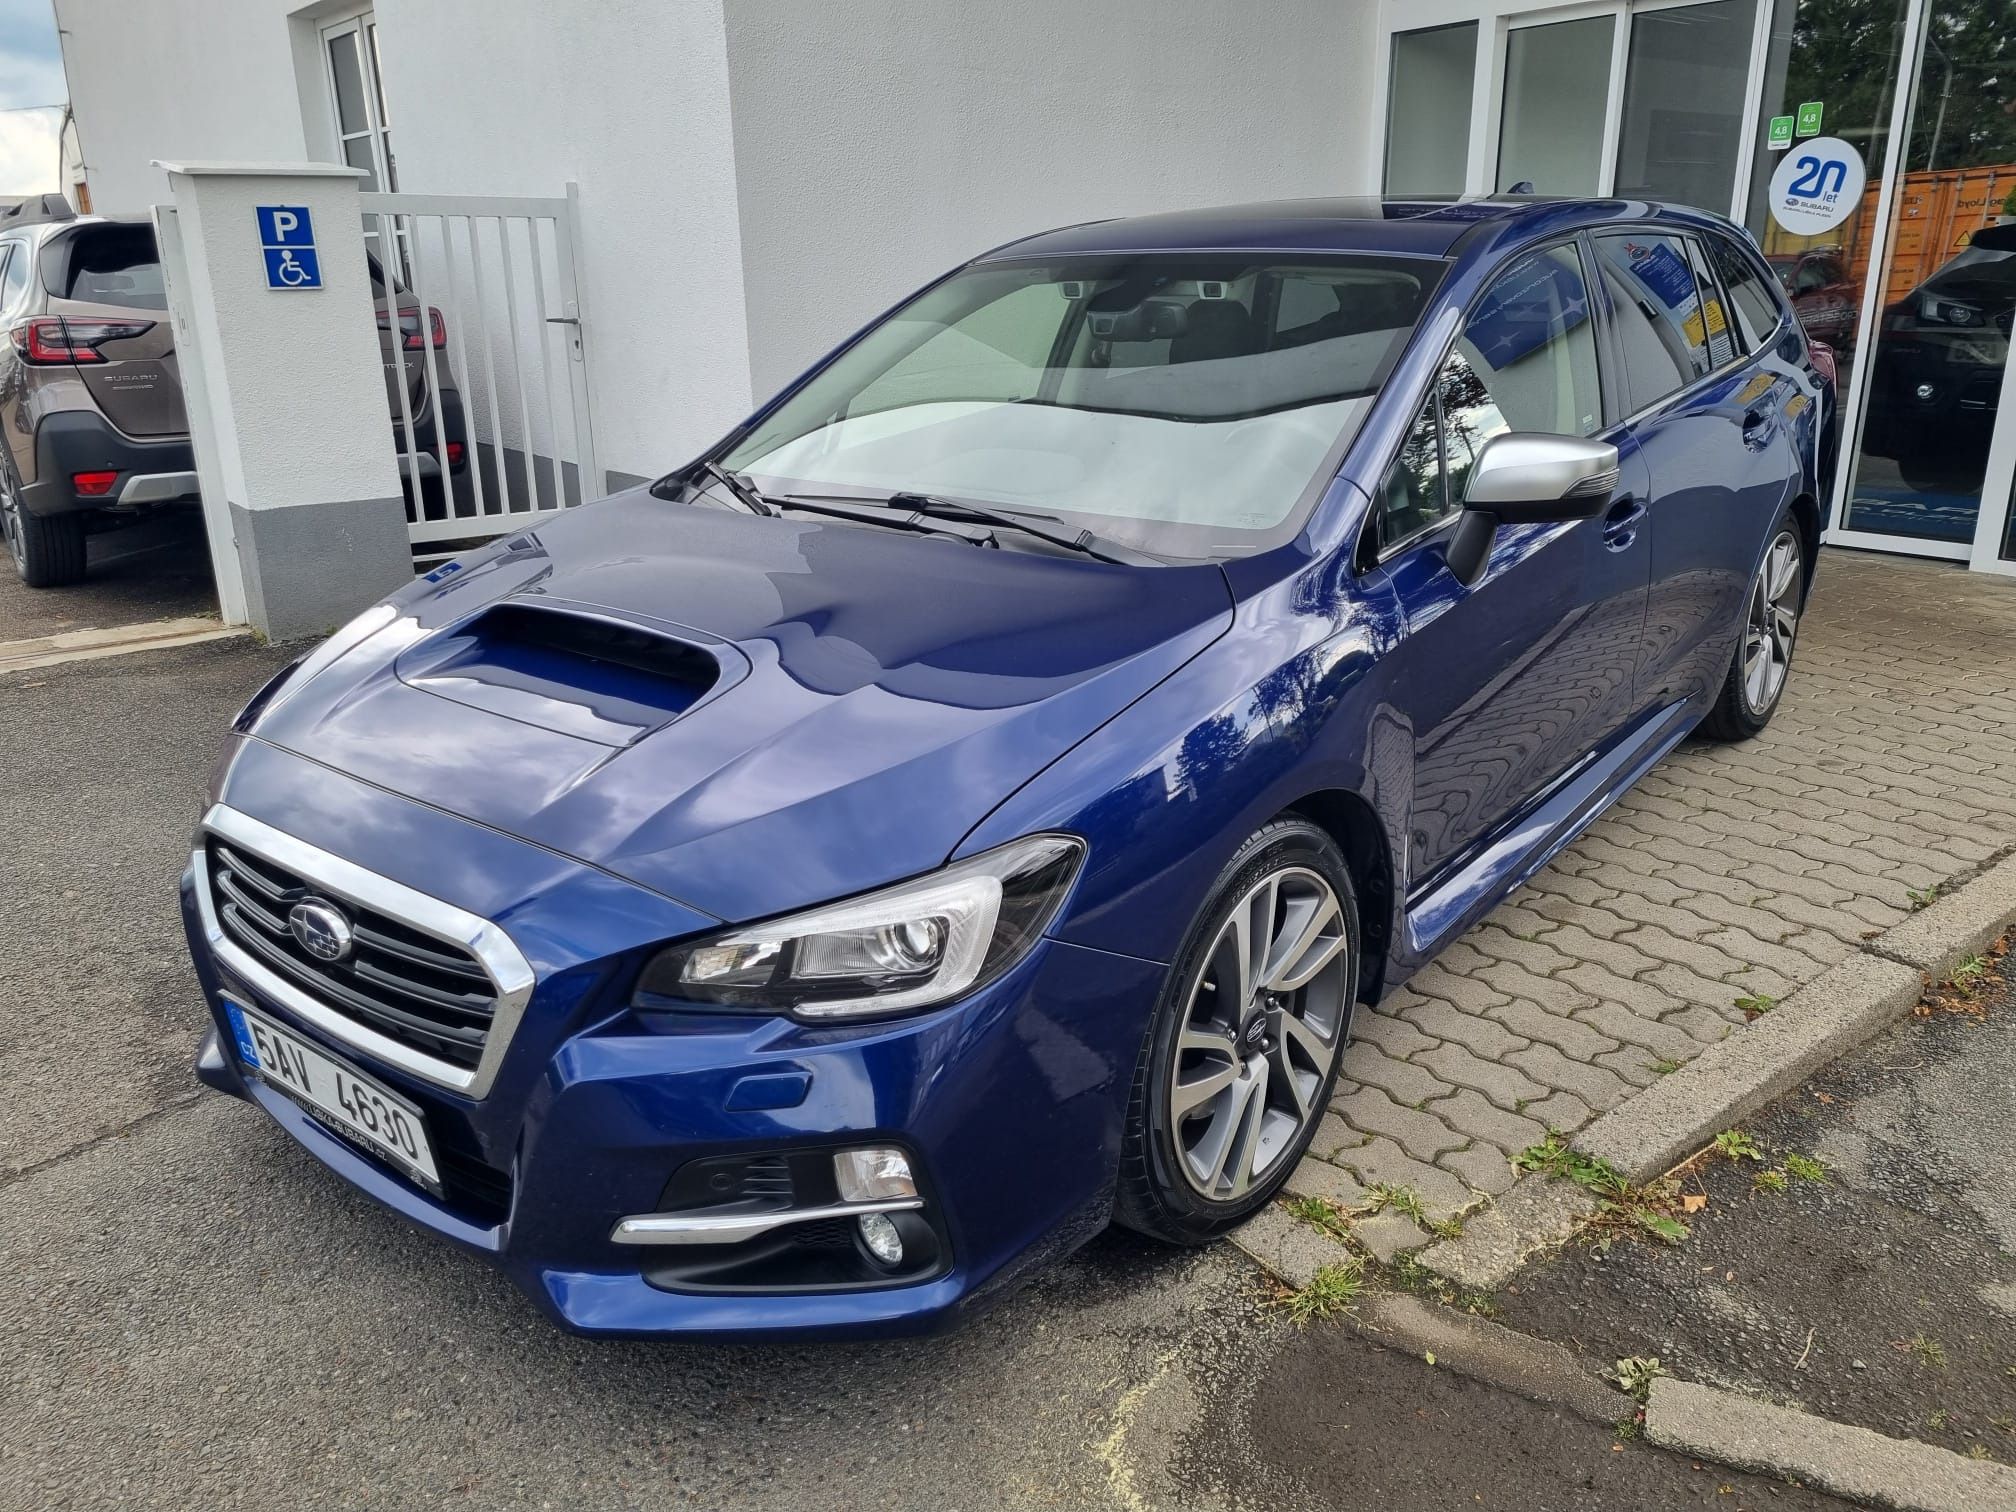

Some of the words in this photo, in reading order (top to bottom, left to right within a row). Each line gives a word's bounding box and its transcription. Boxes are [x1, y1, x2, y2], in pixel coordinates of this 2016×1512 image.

[1803, 114, 1816, 123] 4,8
[1775, 126, 1788, 136] 4,8
[1823, 190, 1838, 203] let
[1800, 201, 1834, 212] SUBARU
[273, 211, 298, 241] P
[103, 374, 158, 382] SUBARU
[240, 1041, 257, 1059] CZ
[250, 1021, 313, 1094] 5AV
[336, 1071, 420, 1161] 4630
